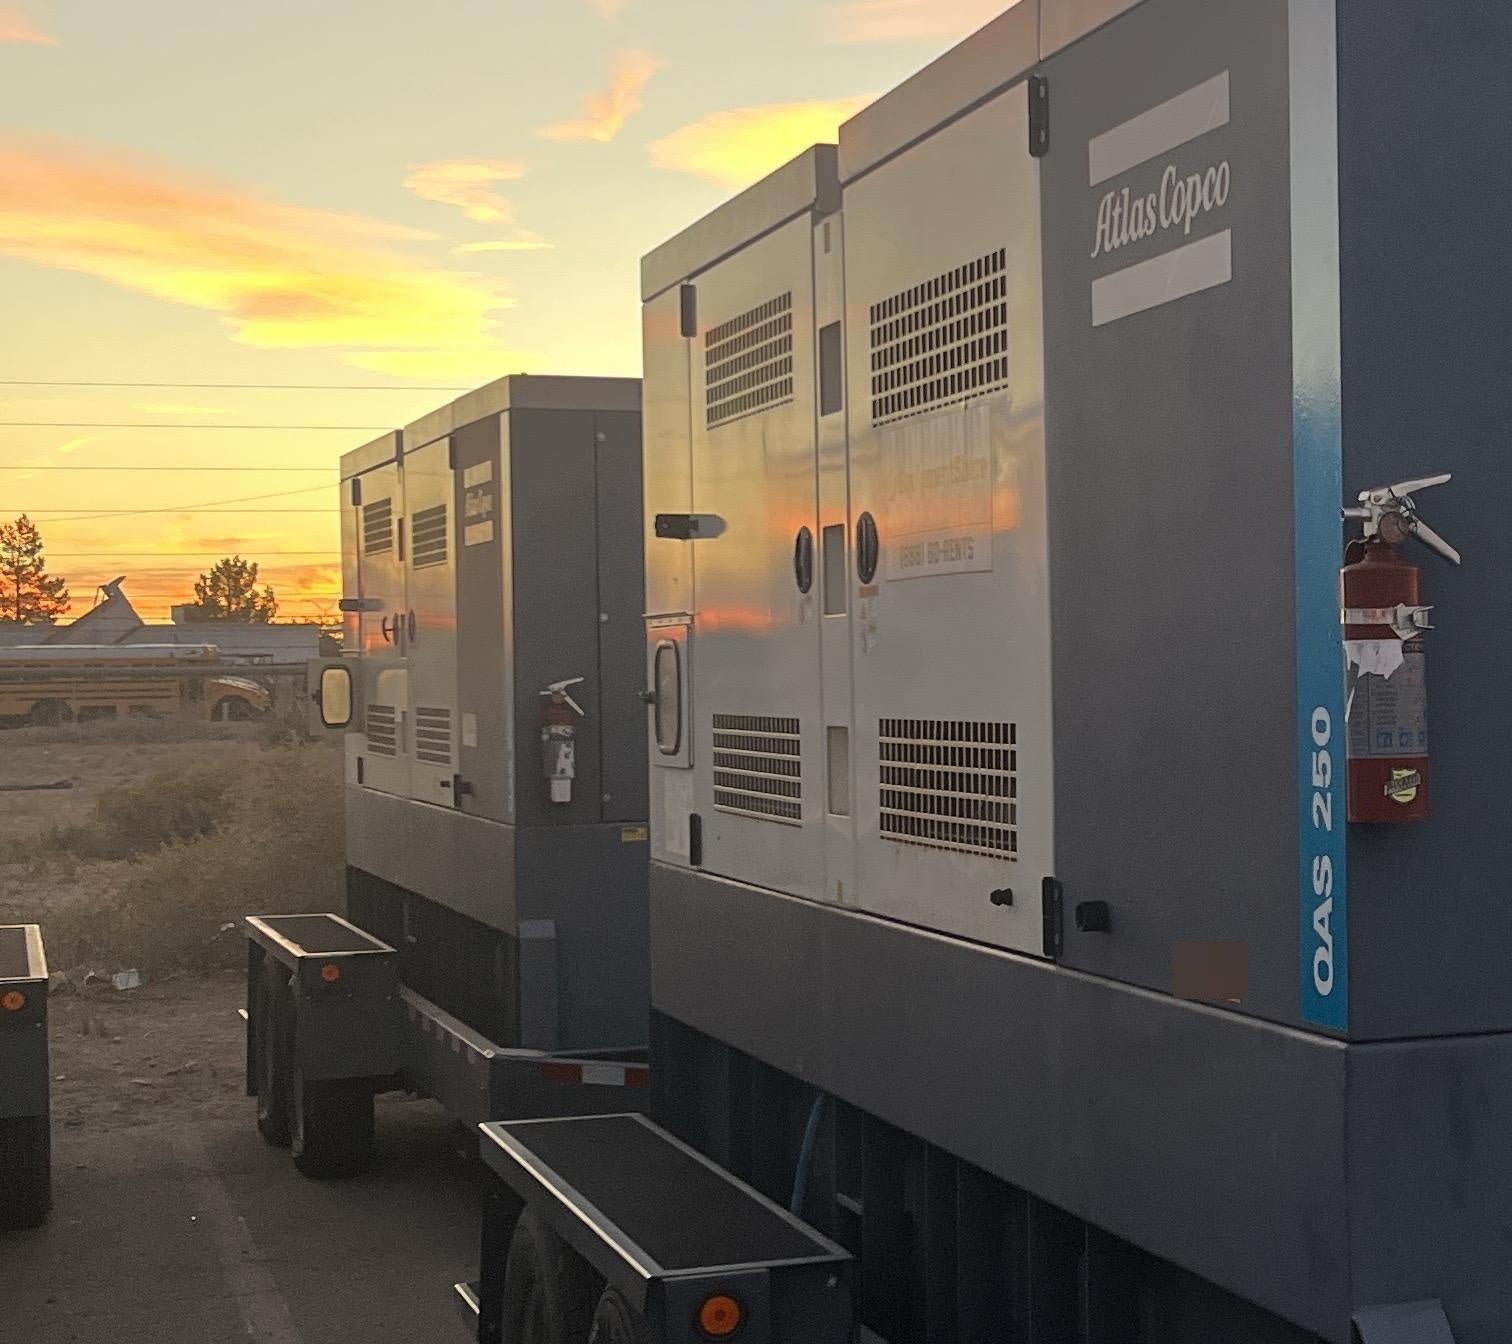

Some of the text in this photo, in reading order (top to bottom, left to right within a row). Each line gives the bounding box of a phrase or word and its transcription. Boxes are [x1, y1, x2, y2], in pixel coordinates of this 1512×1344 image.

[1090, 160, 1231, 258] Atlas Copco
[1311, 705, 1334, 997] QAS 250
